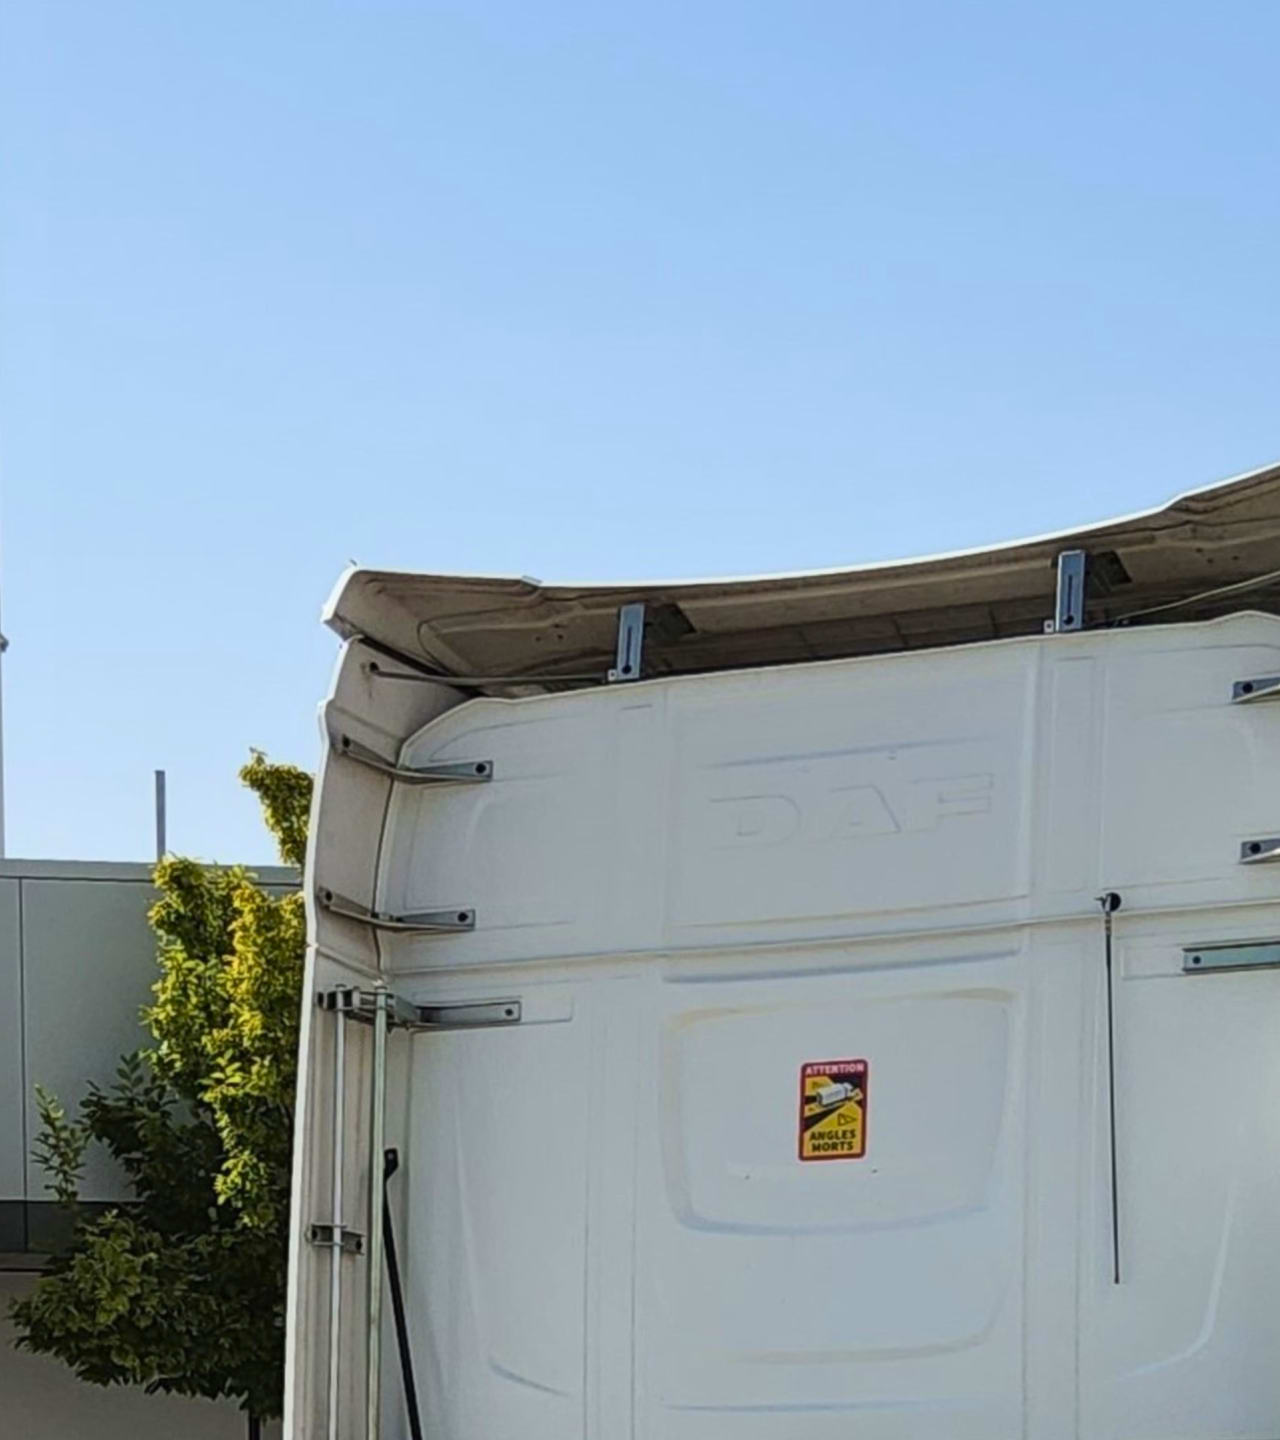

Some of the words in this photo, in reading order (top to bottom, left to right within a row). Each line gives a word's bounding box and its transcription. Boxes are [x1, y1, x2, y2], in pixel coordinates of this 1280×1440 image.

[706, 773, 995, 850] DAF
[805, 1063, 865, 1075] ATTENTION
[810, 1129, 857, 1141] ANGLES
[811, 1141, 854, 1152] MORTS
